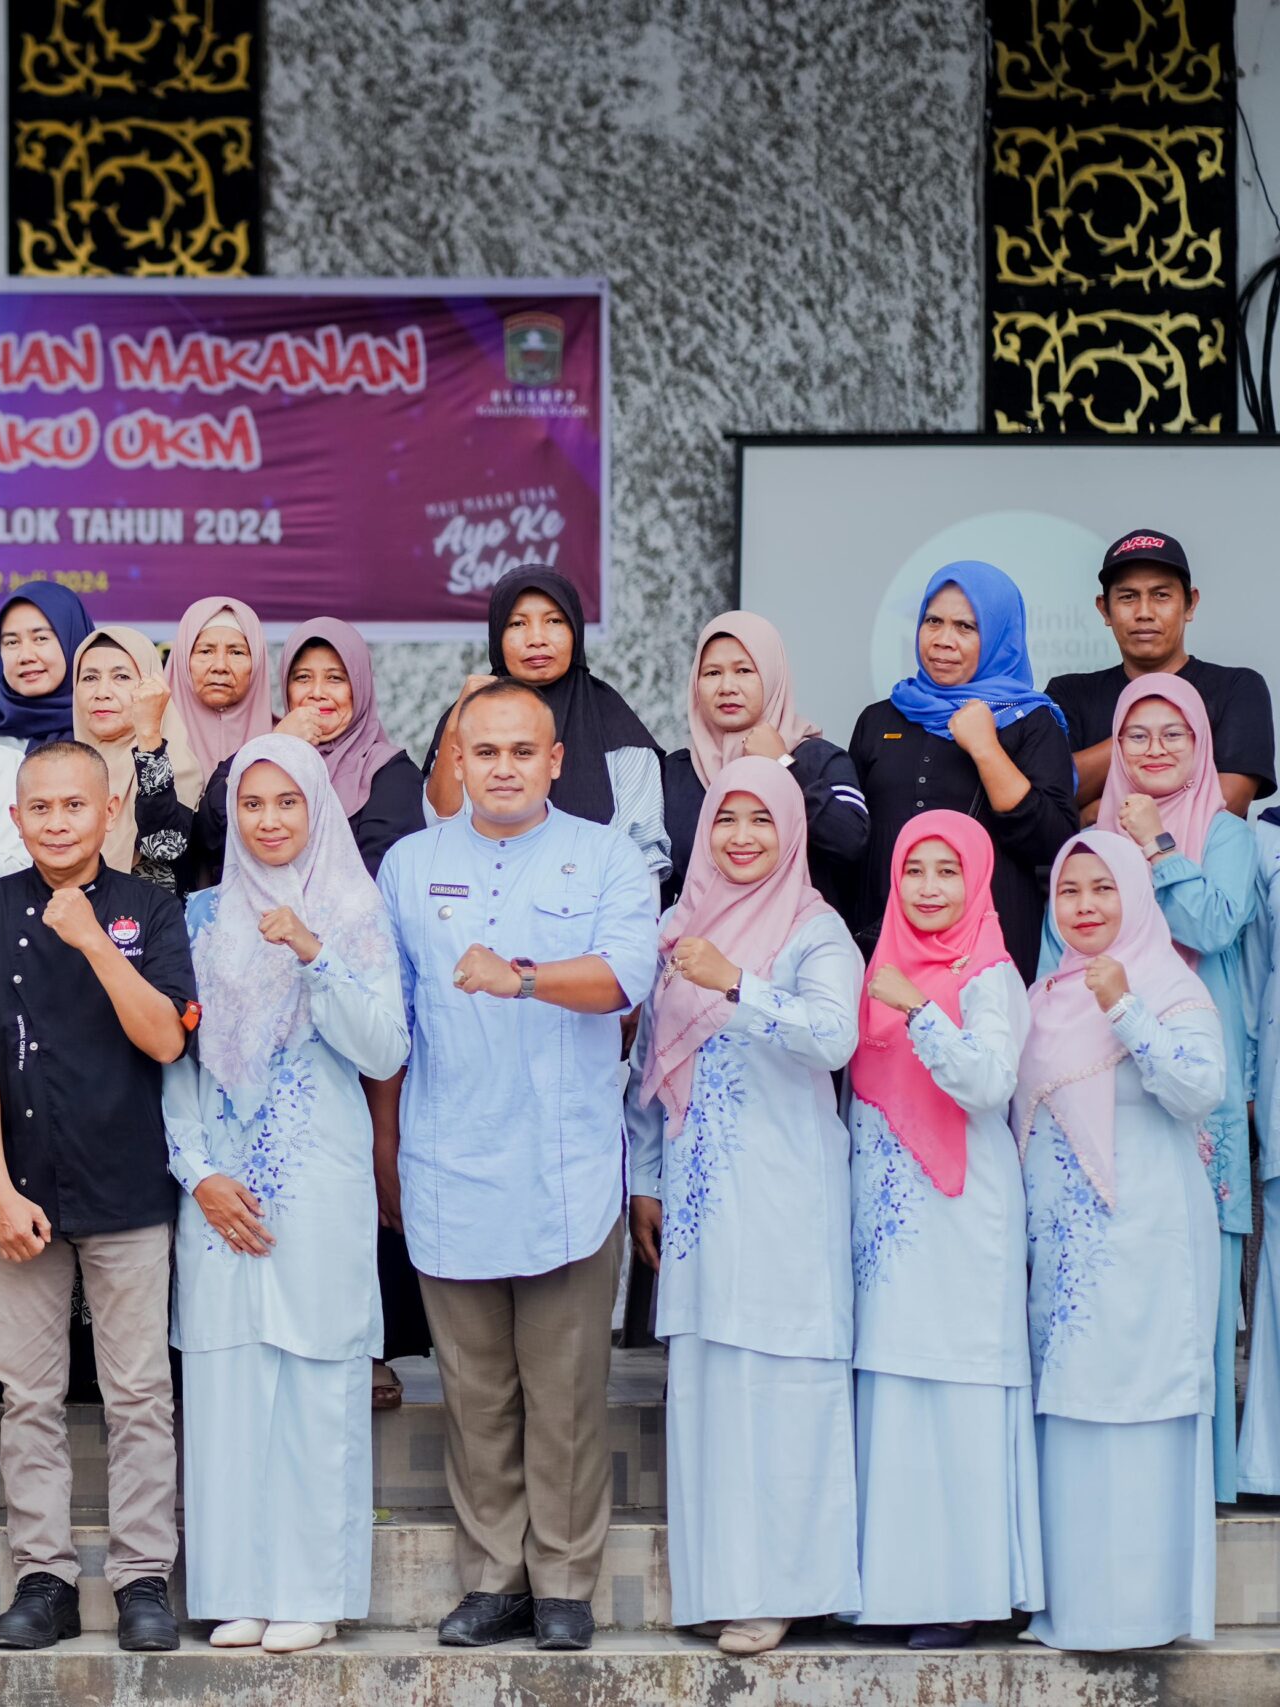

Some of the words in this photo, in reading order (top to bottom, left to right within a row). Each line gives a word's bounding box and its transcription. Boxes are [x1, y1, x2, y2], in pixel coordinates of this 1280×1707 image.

[111, 325, 426, 394] MAKANAN
[105, 406, 262, 473] UKM
[69, 508, 183, 544] TAHUN
[194, 508, 283, 544] 2024
[433, 515, 510, 560] Ayo
[510, 503, 565, 544] Ke
[1113, 535, 1165, 556] ARM
[1028, 603, 1089, 631] linik
[1032, 639, 1110, 658] esain
